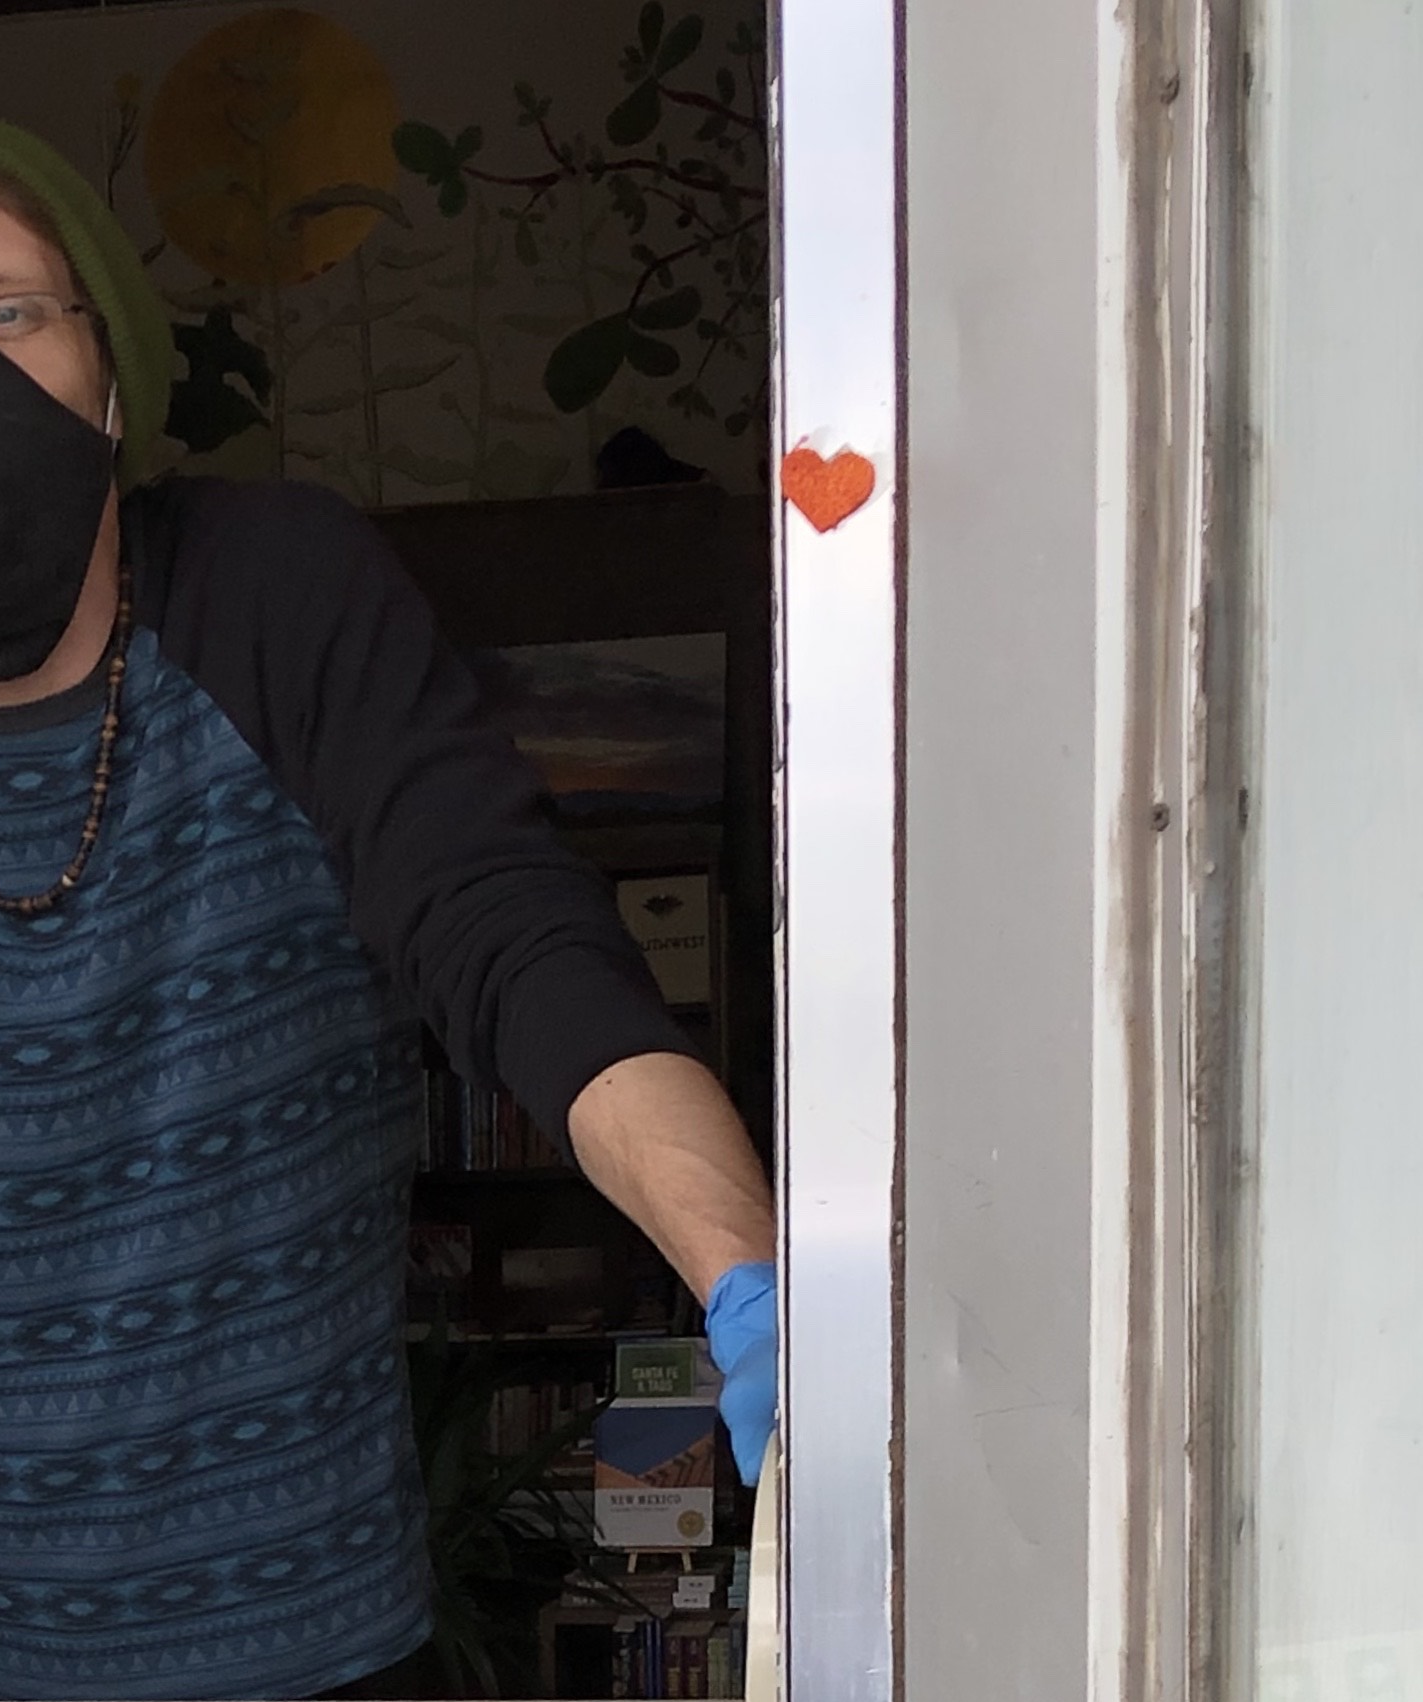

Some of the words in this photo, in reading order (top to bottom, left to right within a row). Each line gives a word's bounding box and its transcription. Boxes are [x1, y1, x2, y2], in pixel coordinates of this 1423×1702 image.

[642, 935, 705, 951] UTHWEST
[632, 1366, 663, 1380] SANTA
[666, 1366, 679, 1380] FE
[648, 1380, 673, 1393] TAOS
[610, 1495, 634, 1505] NEW
[638, 1494, 682, 1505] MEXICO
